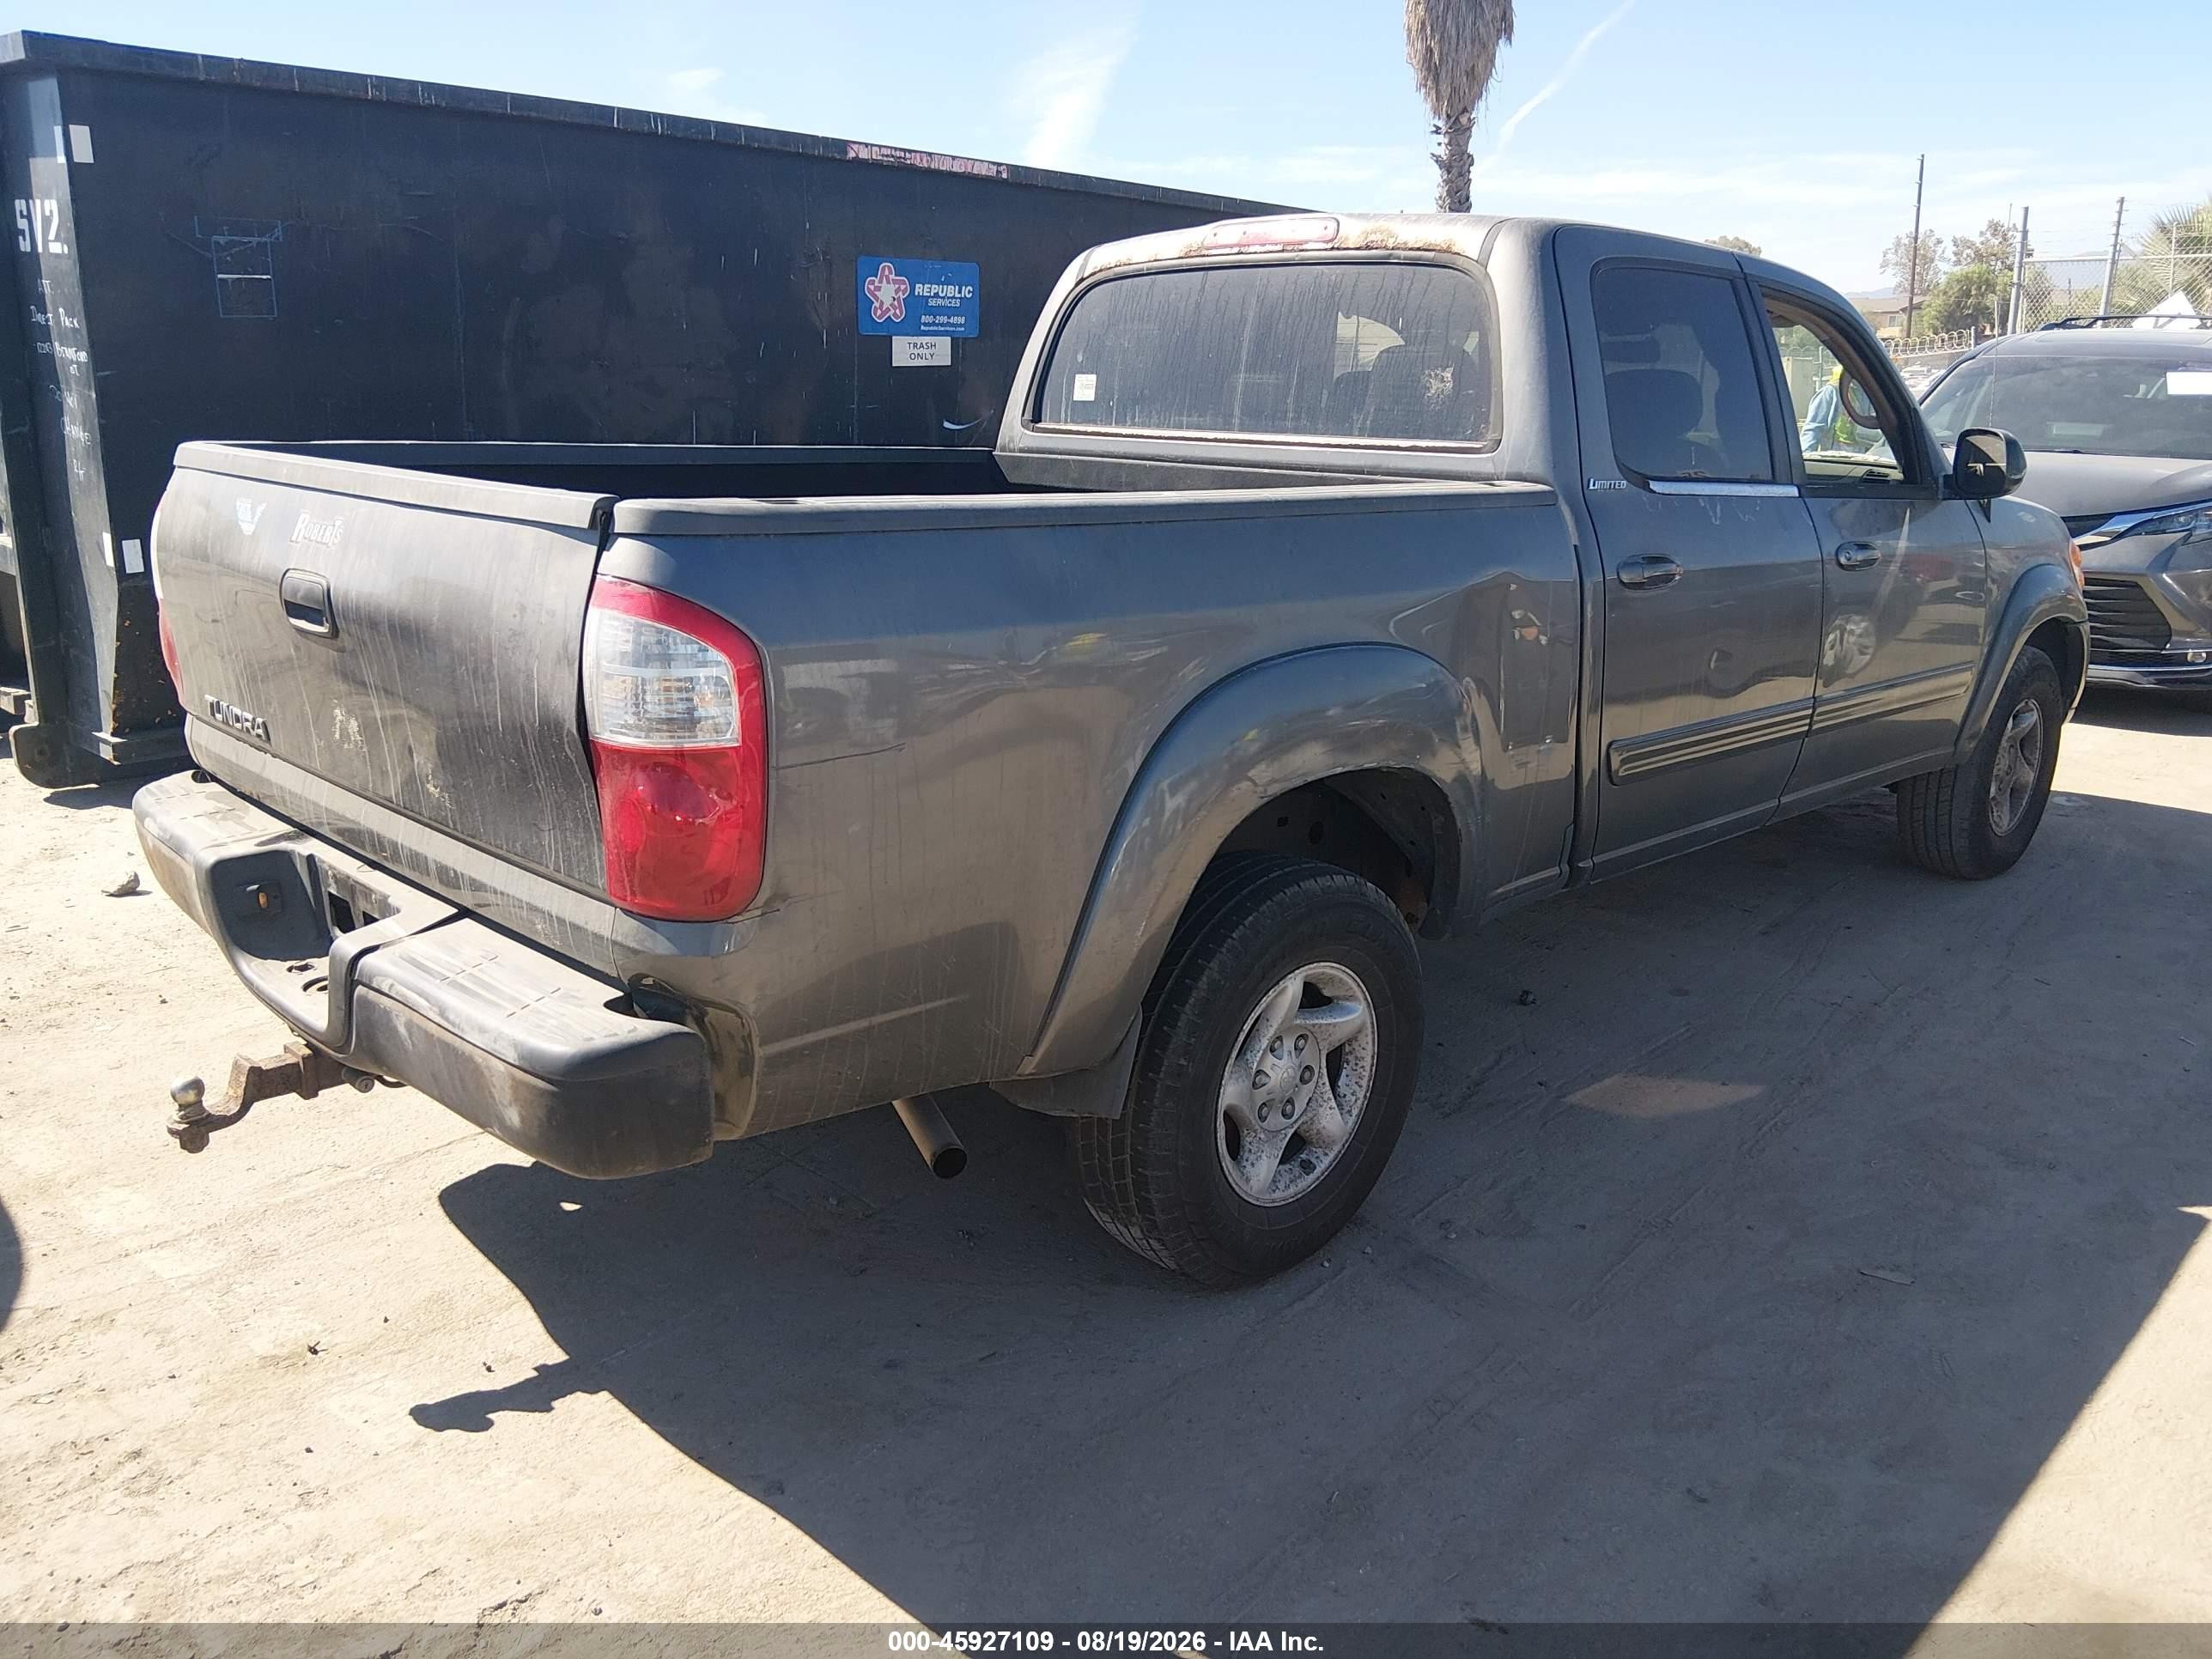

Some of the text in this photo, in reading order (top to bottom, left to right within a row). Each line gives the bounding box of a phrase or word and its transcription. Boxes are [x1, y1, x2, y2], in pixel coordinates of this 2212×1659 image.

[915, 283, 973, 298] REPUBLIC
[927, 298, 961, 307] SERVICES
[907, 342, 937, 350] TRASH
[909, 352, 935, 361] ONLY
[1587, 477, 1627, 490] LIMITED
[204, 694, 272, 744] TUNDRA
